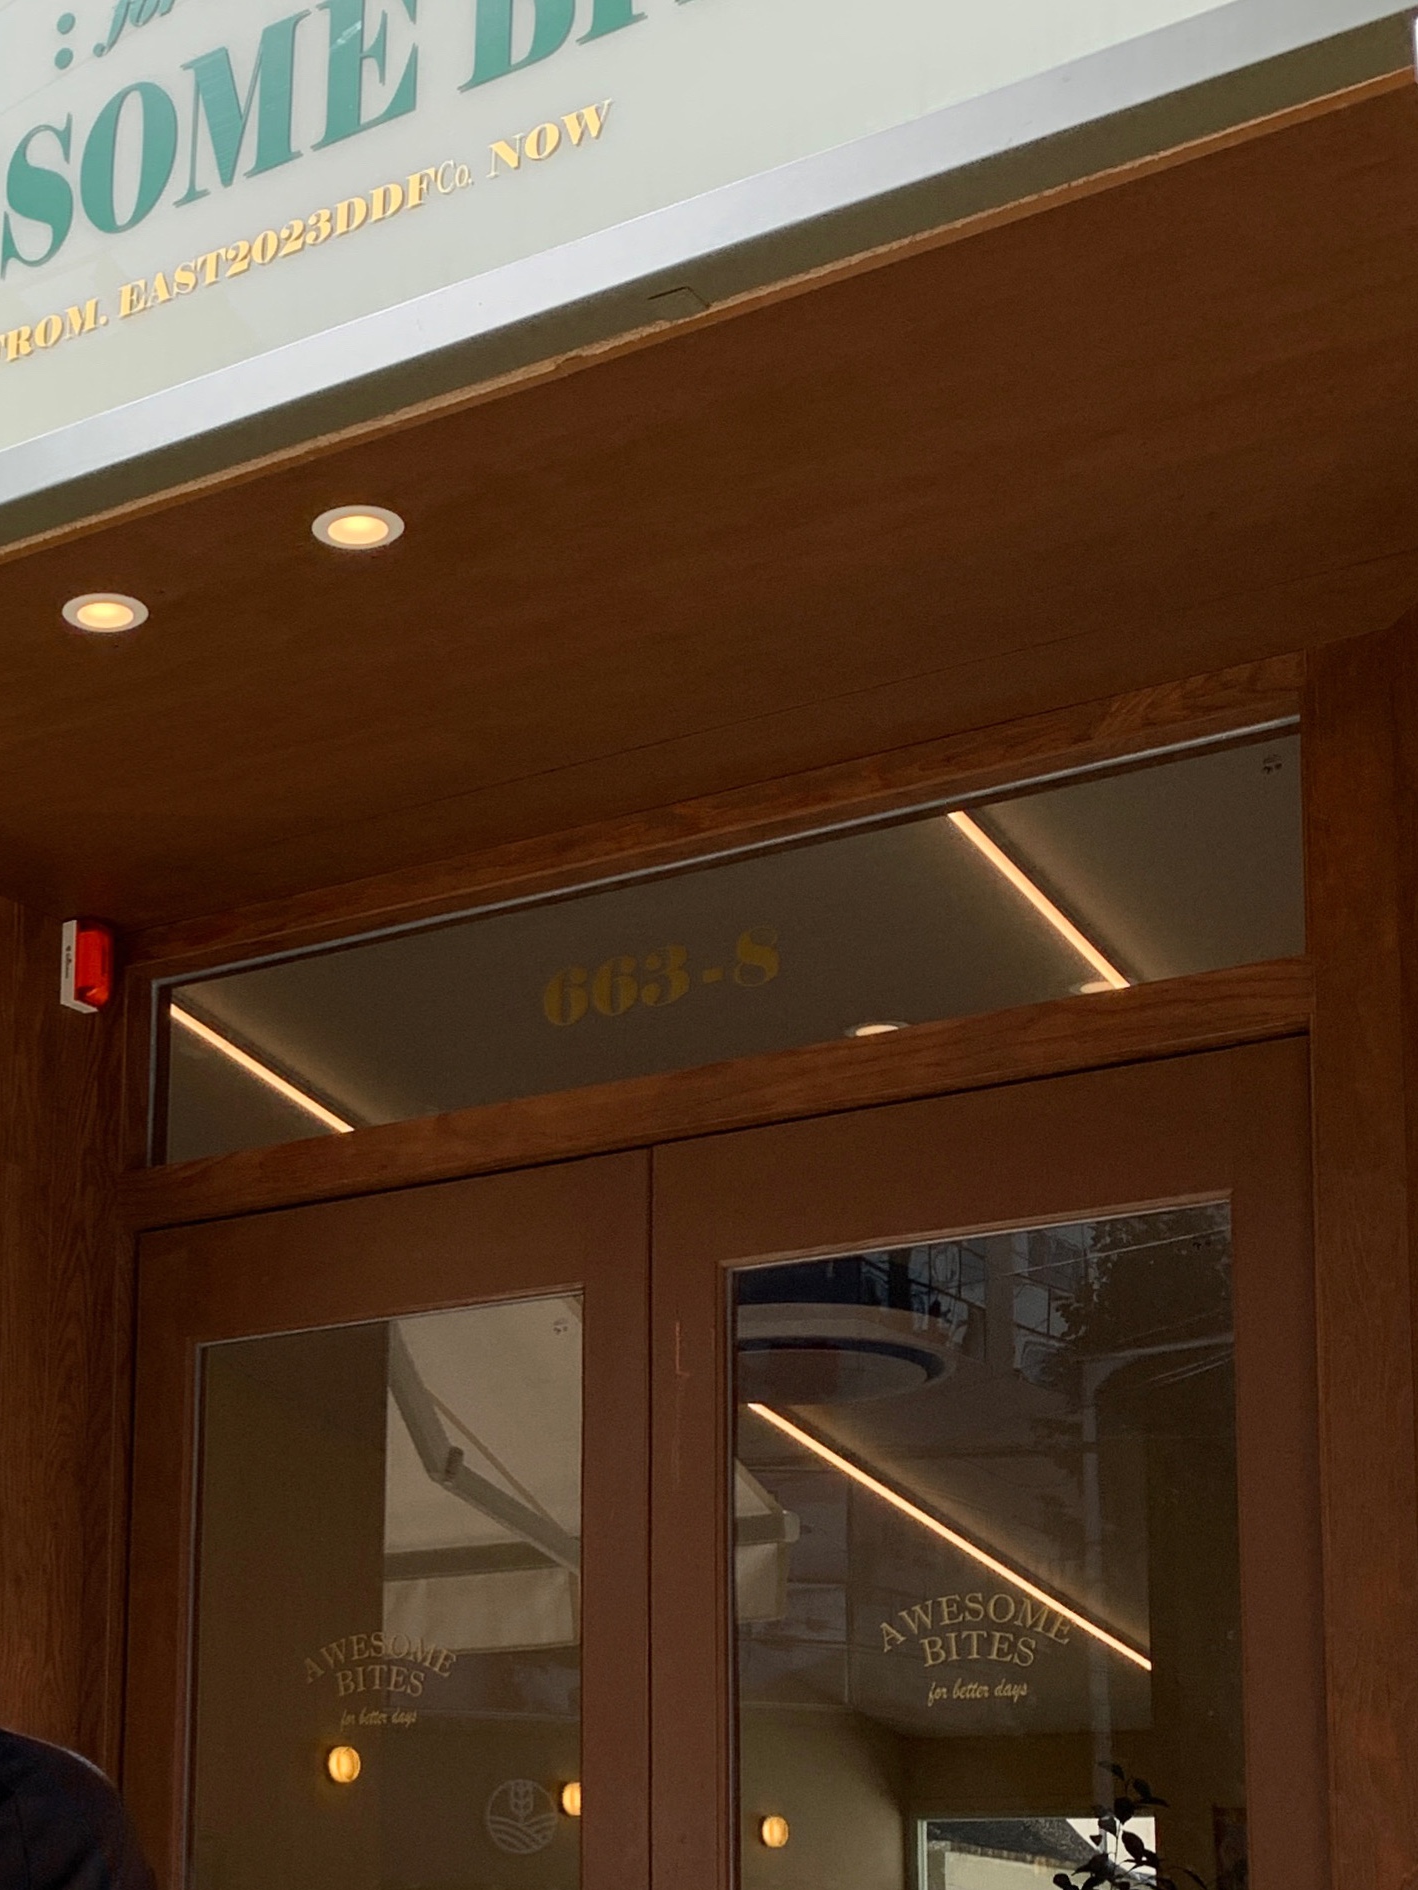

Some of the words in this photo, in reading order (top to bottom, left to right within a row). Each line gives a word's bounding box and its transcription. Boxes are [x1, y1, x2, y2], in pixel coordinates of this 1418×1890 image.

[486, 98, 612, 179] NOW
[543, 926, 780, 1027] 663-8
[880, 1593, 1071, 1652] AWESOME
[919, 1630, 1037, 1667] BITES
[304, 1631, 456, 1684] AWESOME
[336, 1664, 425, 1697] BITES
[927, 1682, 948, 1707] for
[952, 1678, 990, 1700] better
[994, 1679, 1028, 1702] days
